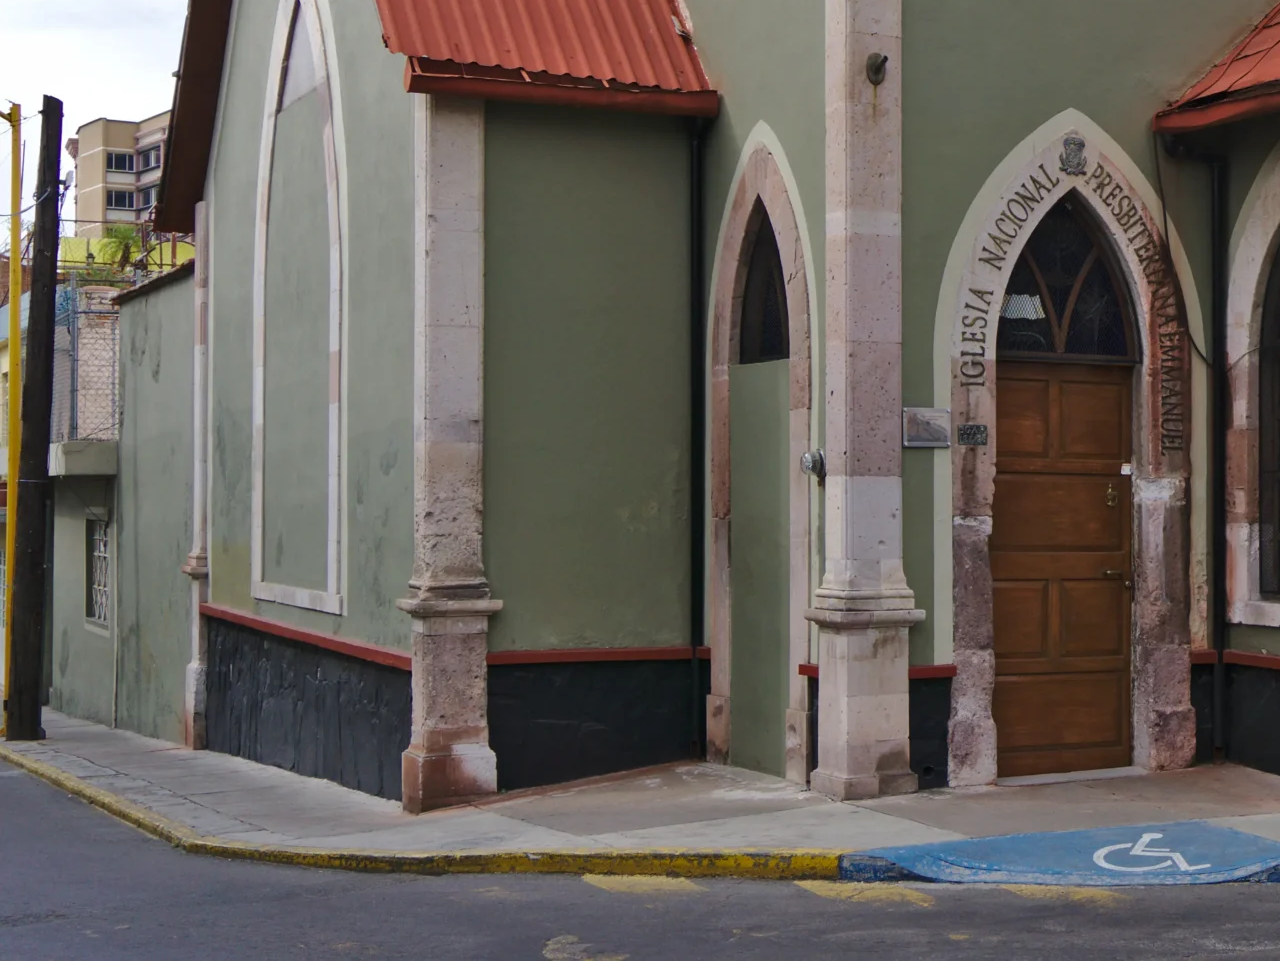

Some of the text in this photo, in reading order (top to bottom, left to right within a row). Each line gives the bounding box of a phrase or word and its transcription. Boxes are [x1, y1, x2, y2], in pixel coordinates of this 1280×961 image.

[960, 161, 1184, 457] IGLESIA NACIONAL PRESBITERIANA EMMANUEL
